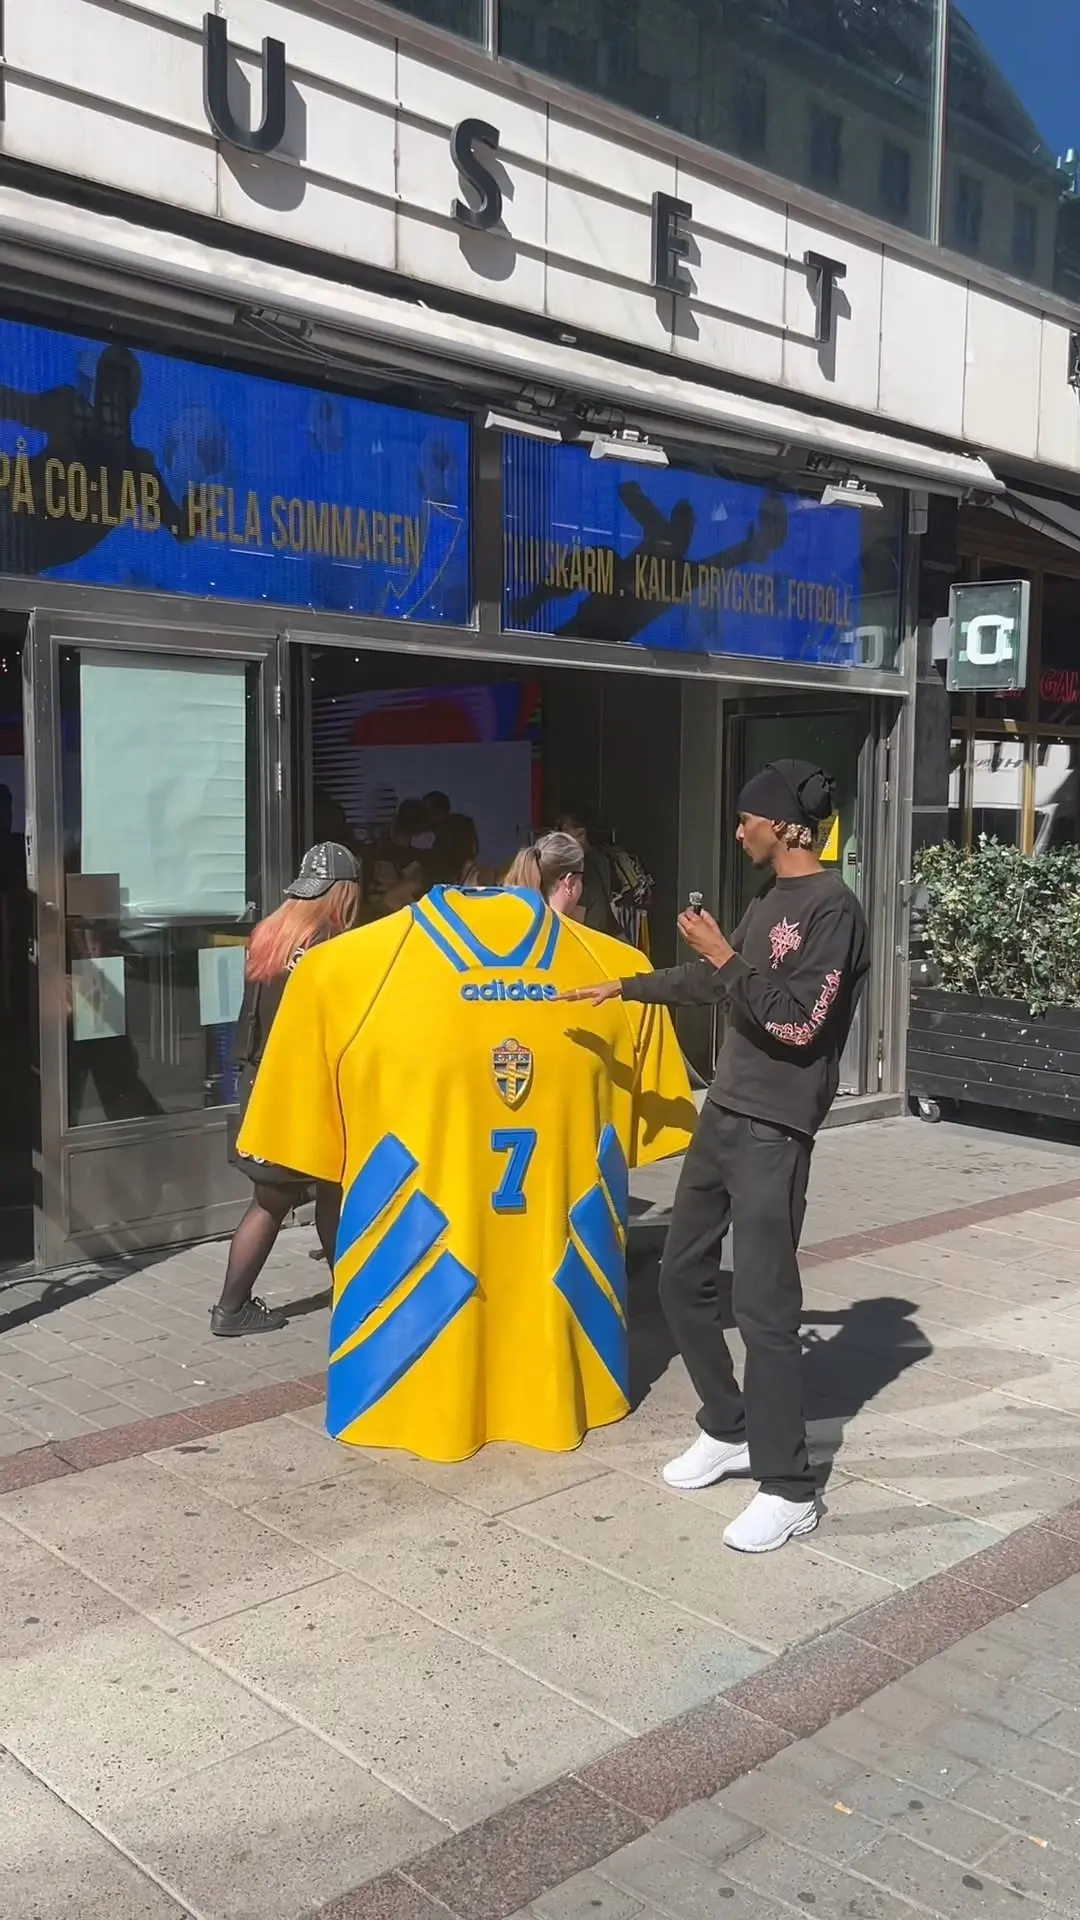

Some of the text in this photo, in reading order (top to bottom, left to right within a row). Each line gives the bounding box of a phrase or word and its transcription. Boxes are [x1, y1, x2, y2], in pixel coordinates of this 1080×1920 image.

[45, 457, 161, 531] CO:LAB
[188, 480, 262, 546] HELA
[271, 495, 419, 567] SOMMAREN
[635, 554, 692, 604] KALLA
[699, 564, 774, 617] DRYCKER
[461, 979, 557, 1001] adidas
[491, 1129, 537, 1214] 7
